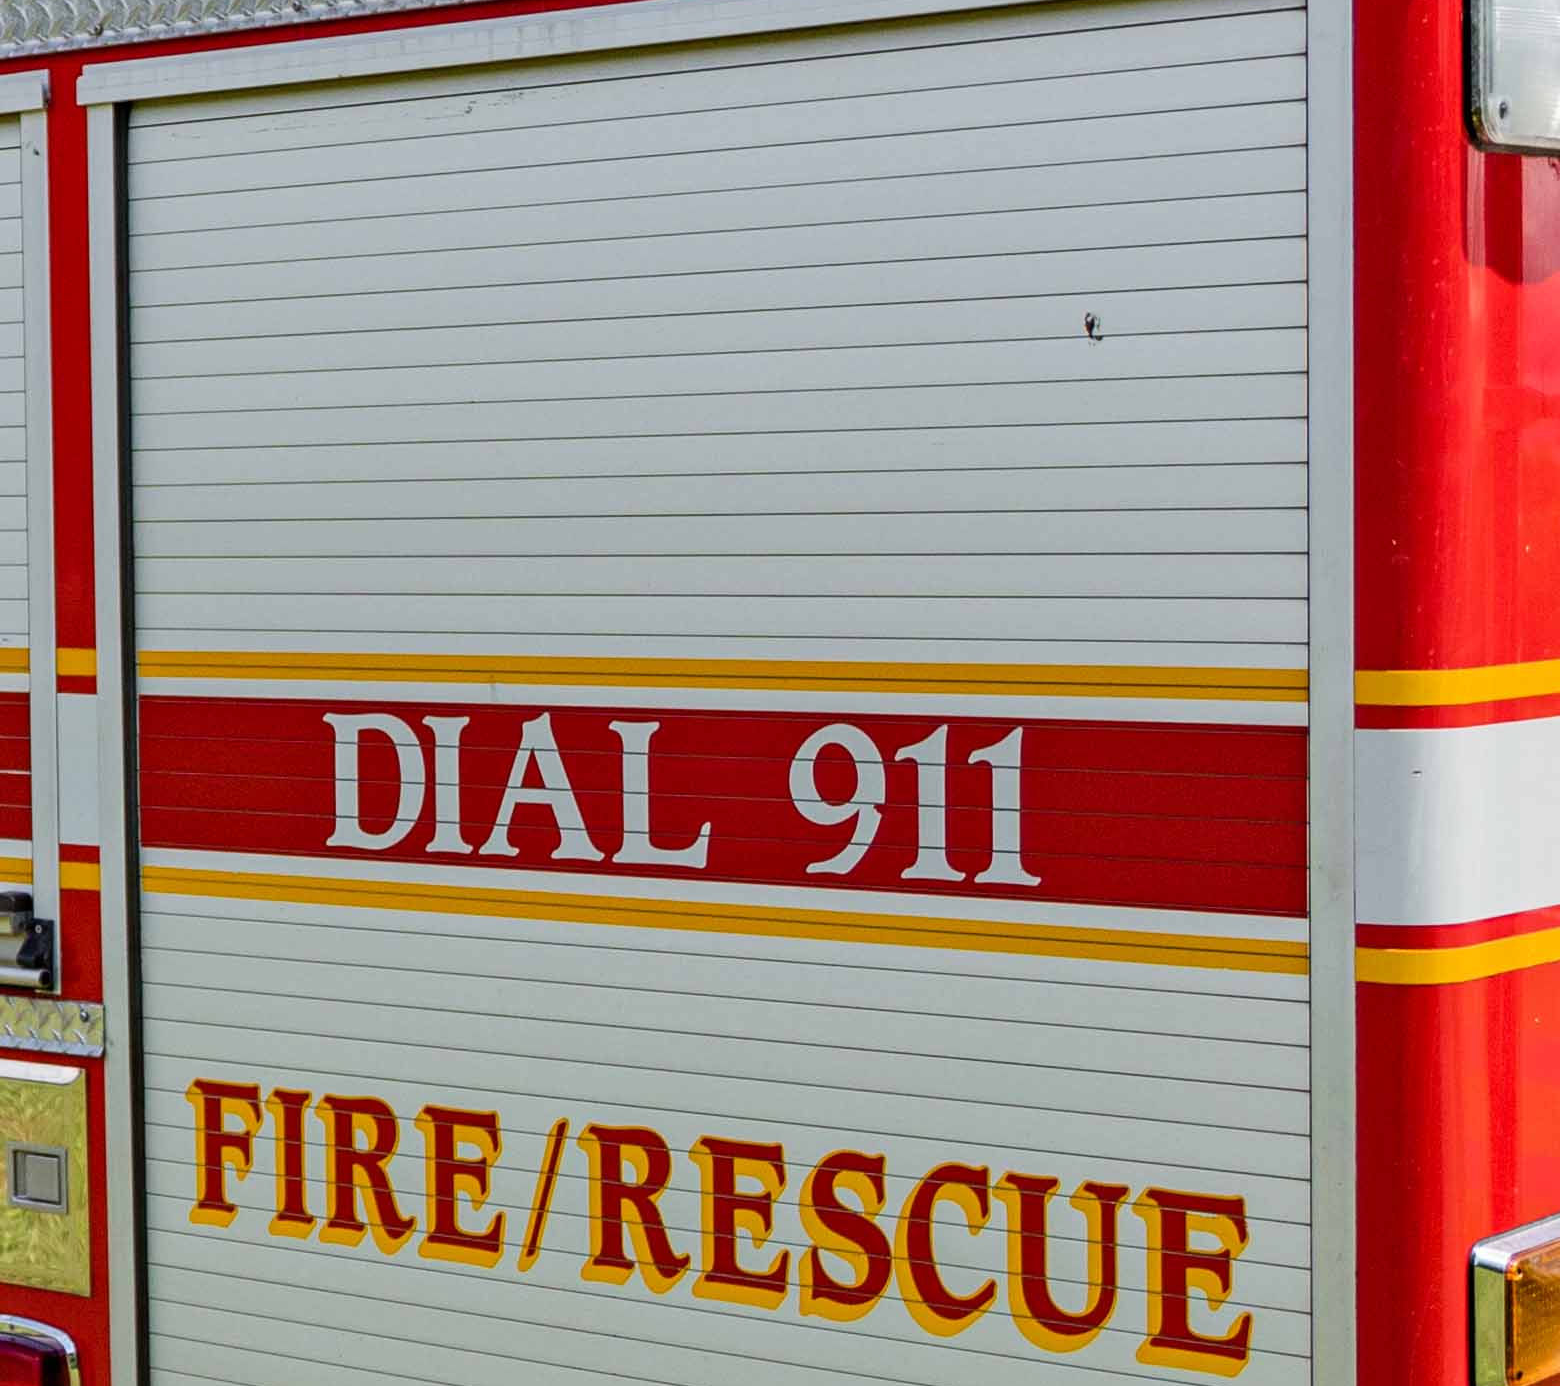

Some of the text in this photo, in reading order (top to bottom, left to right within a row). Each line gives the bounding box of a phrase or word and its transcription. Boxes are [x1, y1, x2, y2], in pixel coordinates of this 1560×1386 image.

[321, 711, 1043, 888] DIAL 911
[186, 1075, 1254, 1379] FIRE/RESCUE
